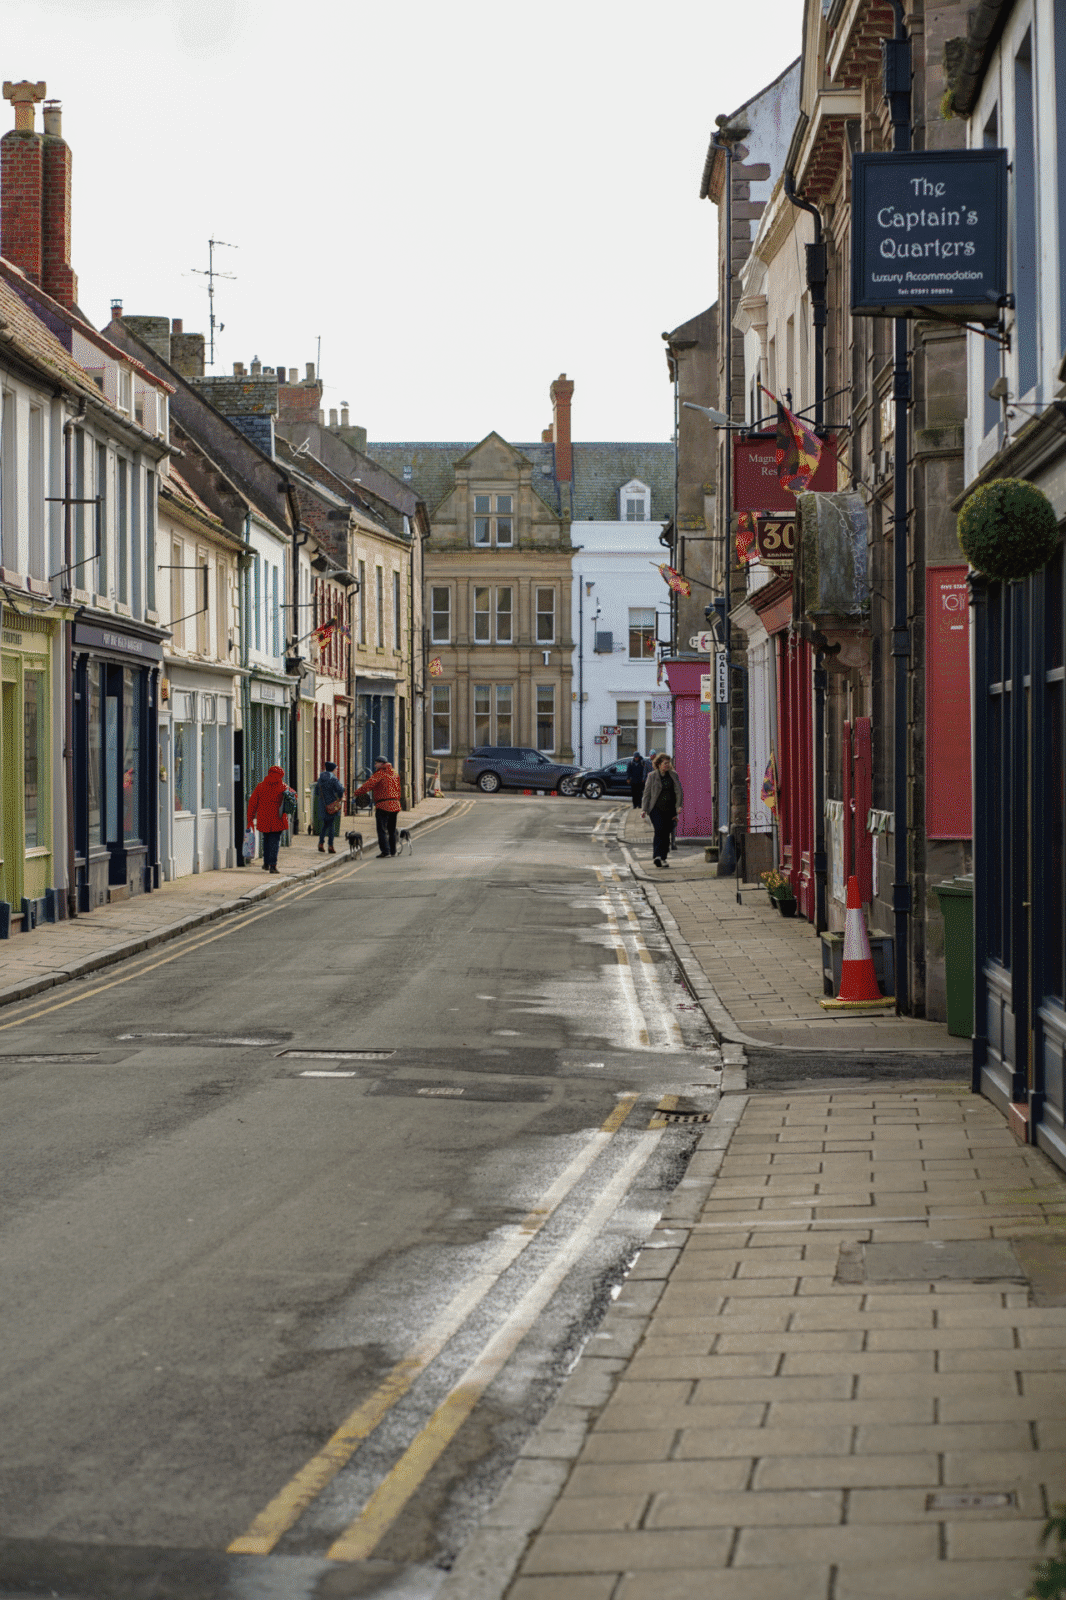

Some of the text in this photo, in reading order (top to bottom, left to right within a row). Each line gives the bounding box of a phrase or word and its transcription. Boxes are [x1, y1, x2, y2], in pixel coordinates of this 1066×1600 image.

[910, 177, 946, 198] The
[877, 205, 979, 232] Captain's
[879, 238, 976, 260] Quarters
[871, 270, 983, 284] Luxury Accommodation
